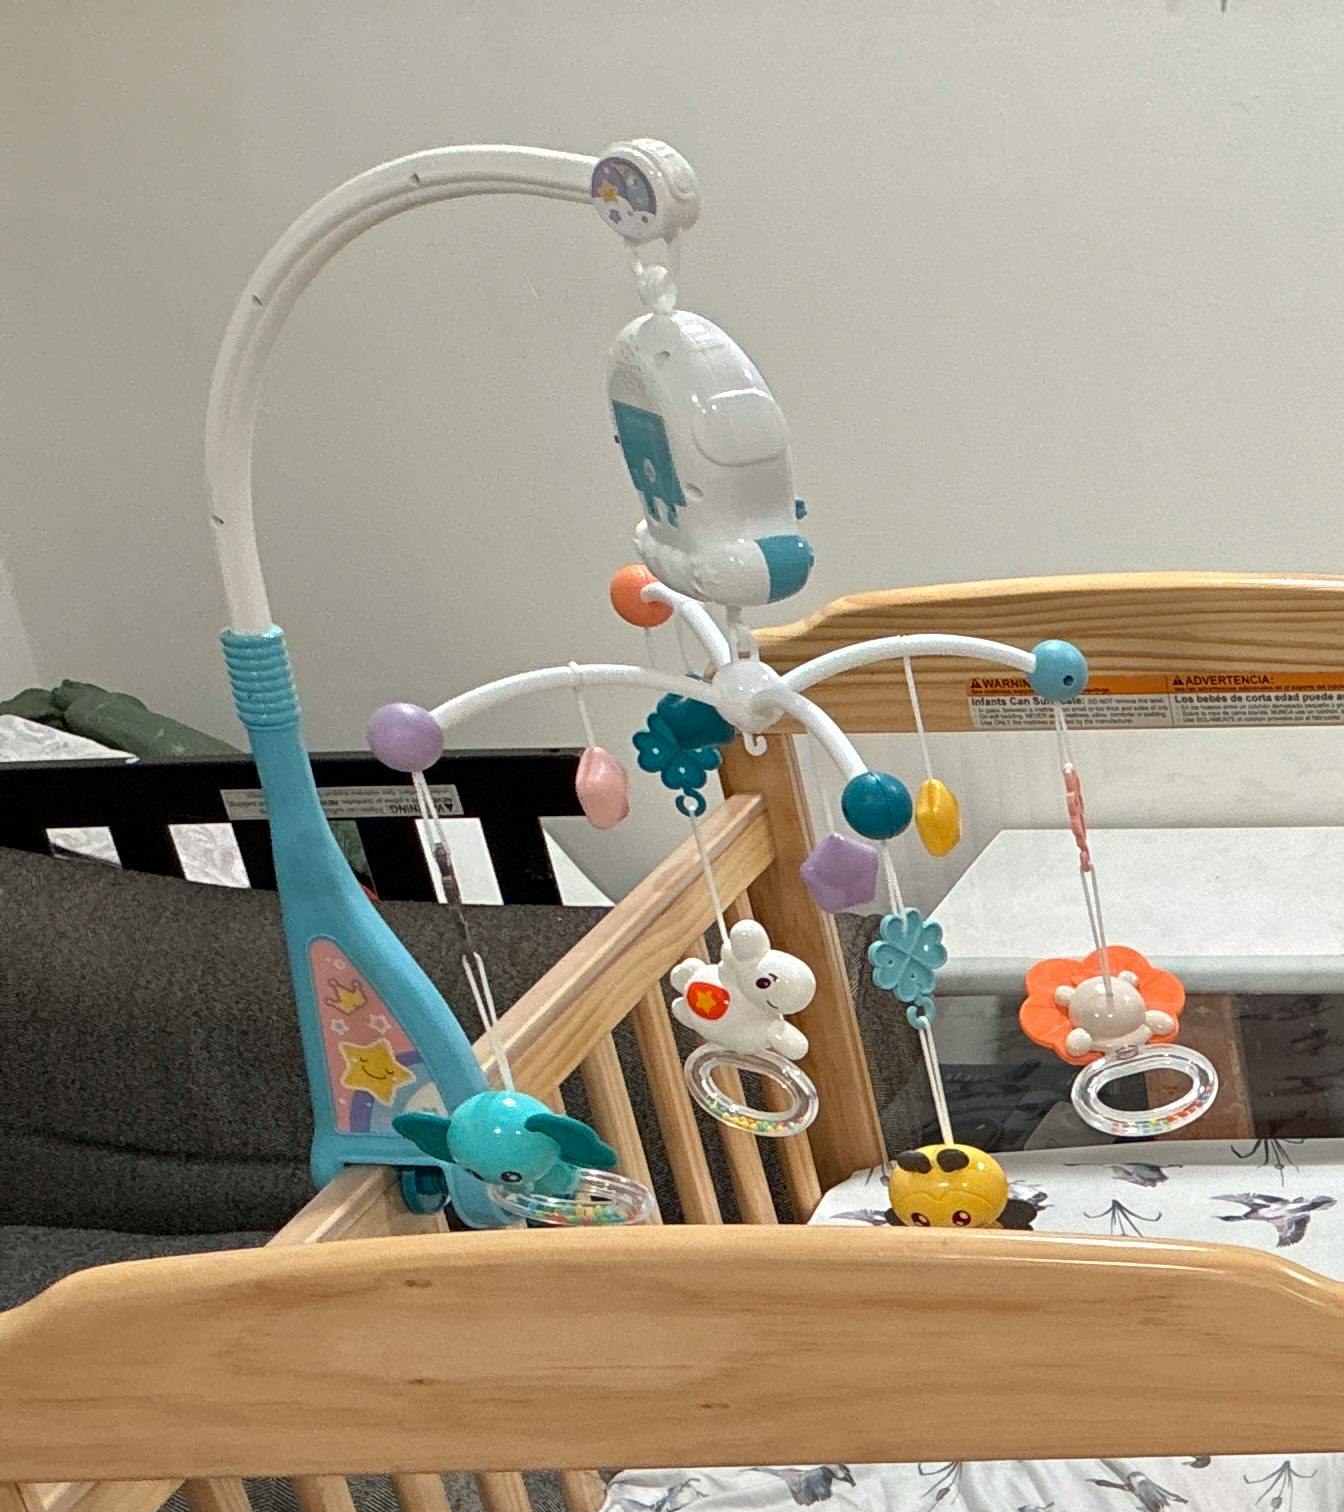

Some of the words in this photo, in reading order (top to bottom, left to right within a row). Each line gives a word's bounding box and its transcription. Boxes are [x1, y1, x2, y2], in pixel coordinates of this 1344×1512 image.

[971, 697, 1007, 706] Infants
[1010, 697, 1031, 706] Can
[1175, 695, 1195, 703] Los
[1197, 694, 1228, 703] bebés
[1230, 694, 1243, 702] de
[1246, 694, 1272, 702] corta
[1274, 693, 1300, 701] edad
[1302, 693, 1334, 702] puede
